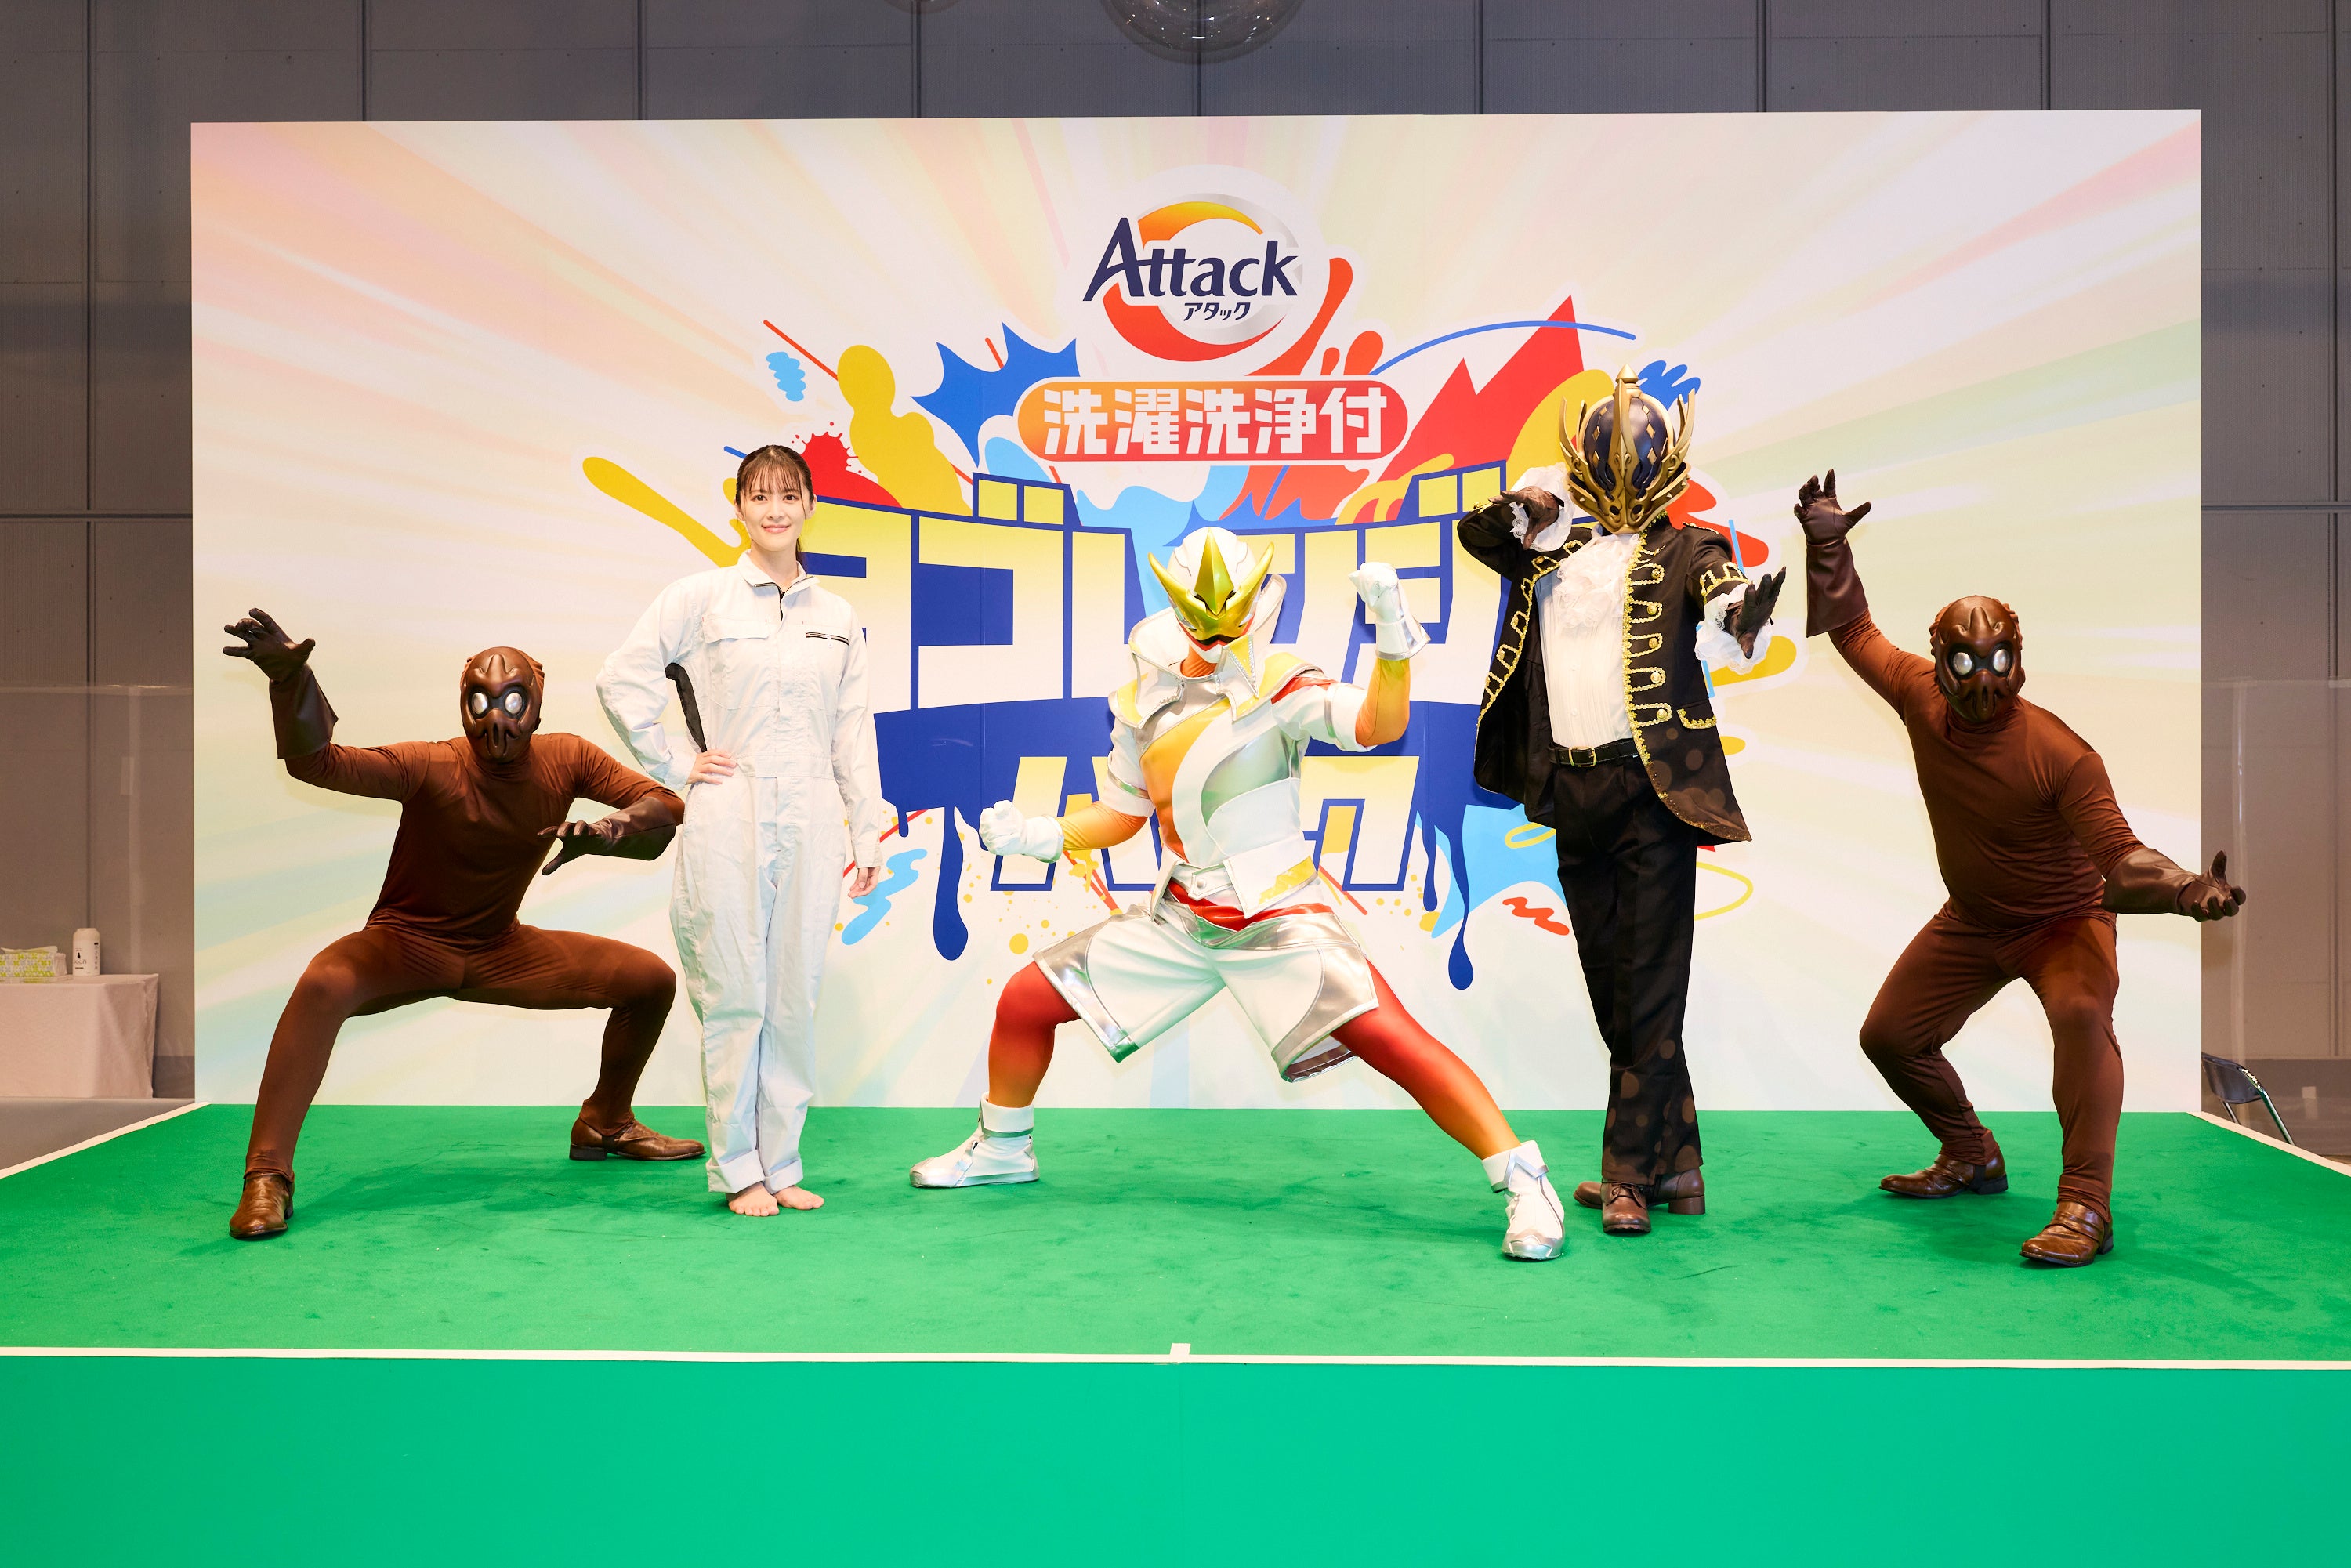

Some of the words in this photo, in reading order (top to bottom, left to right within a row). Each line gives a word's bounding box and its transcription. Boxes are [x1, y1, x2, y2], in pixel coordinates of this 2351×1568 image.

[1082, 217, 1299, 302] Attack
[1183, 302, 1252, 321] アタック
[1043, 386, 1388, 455] 洗濯洗浄付
